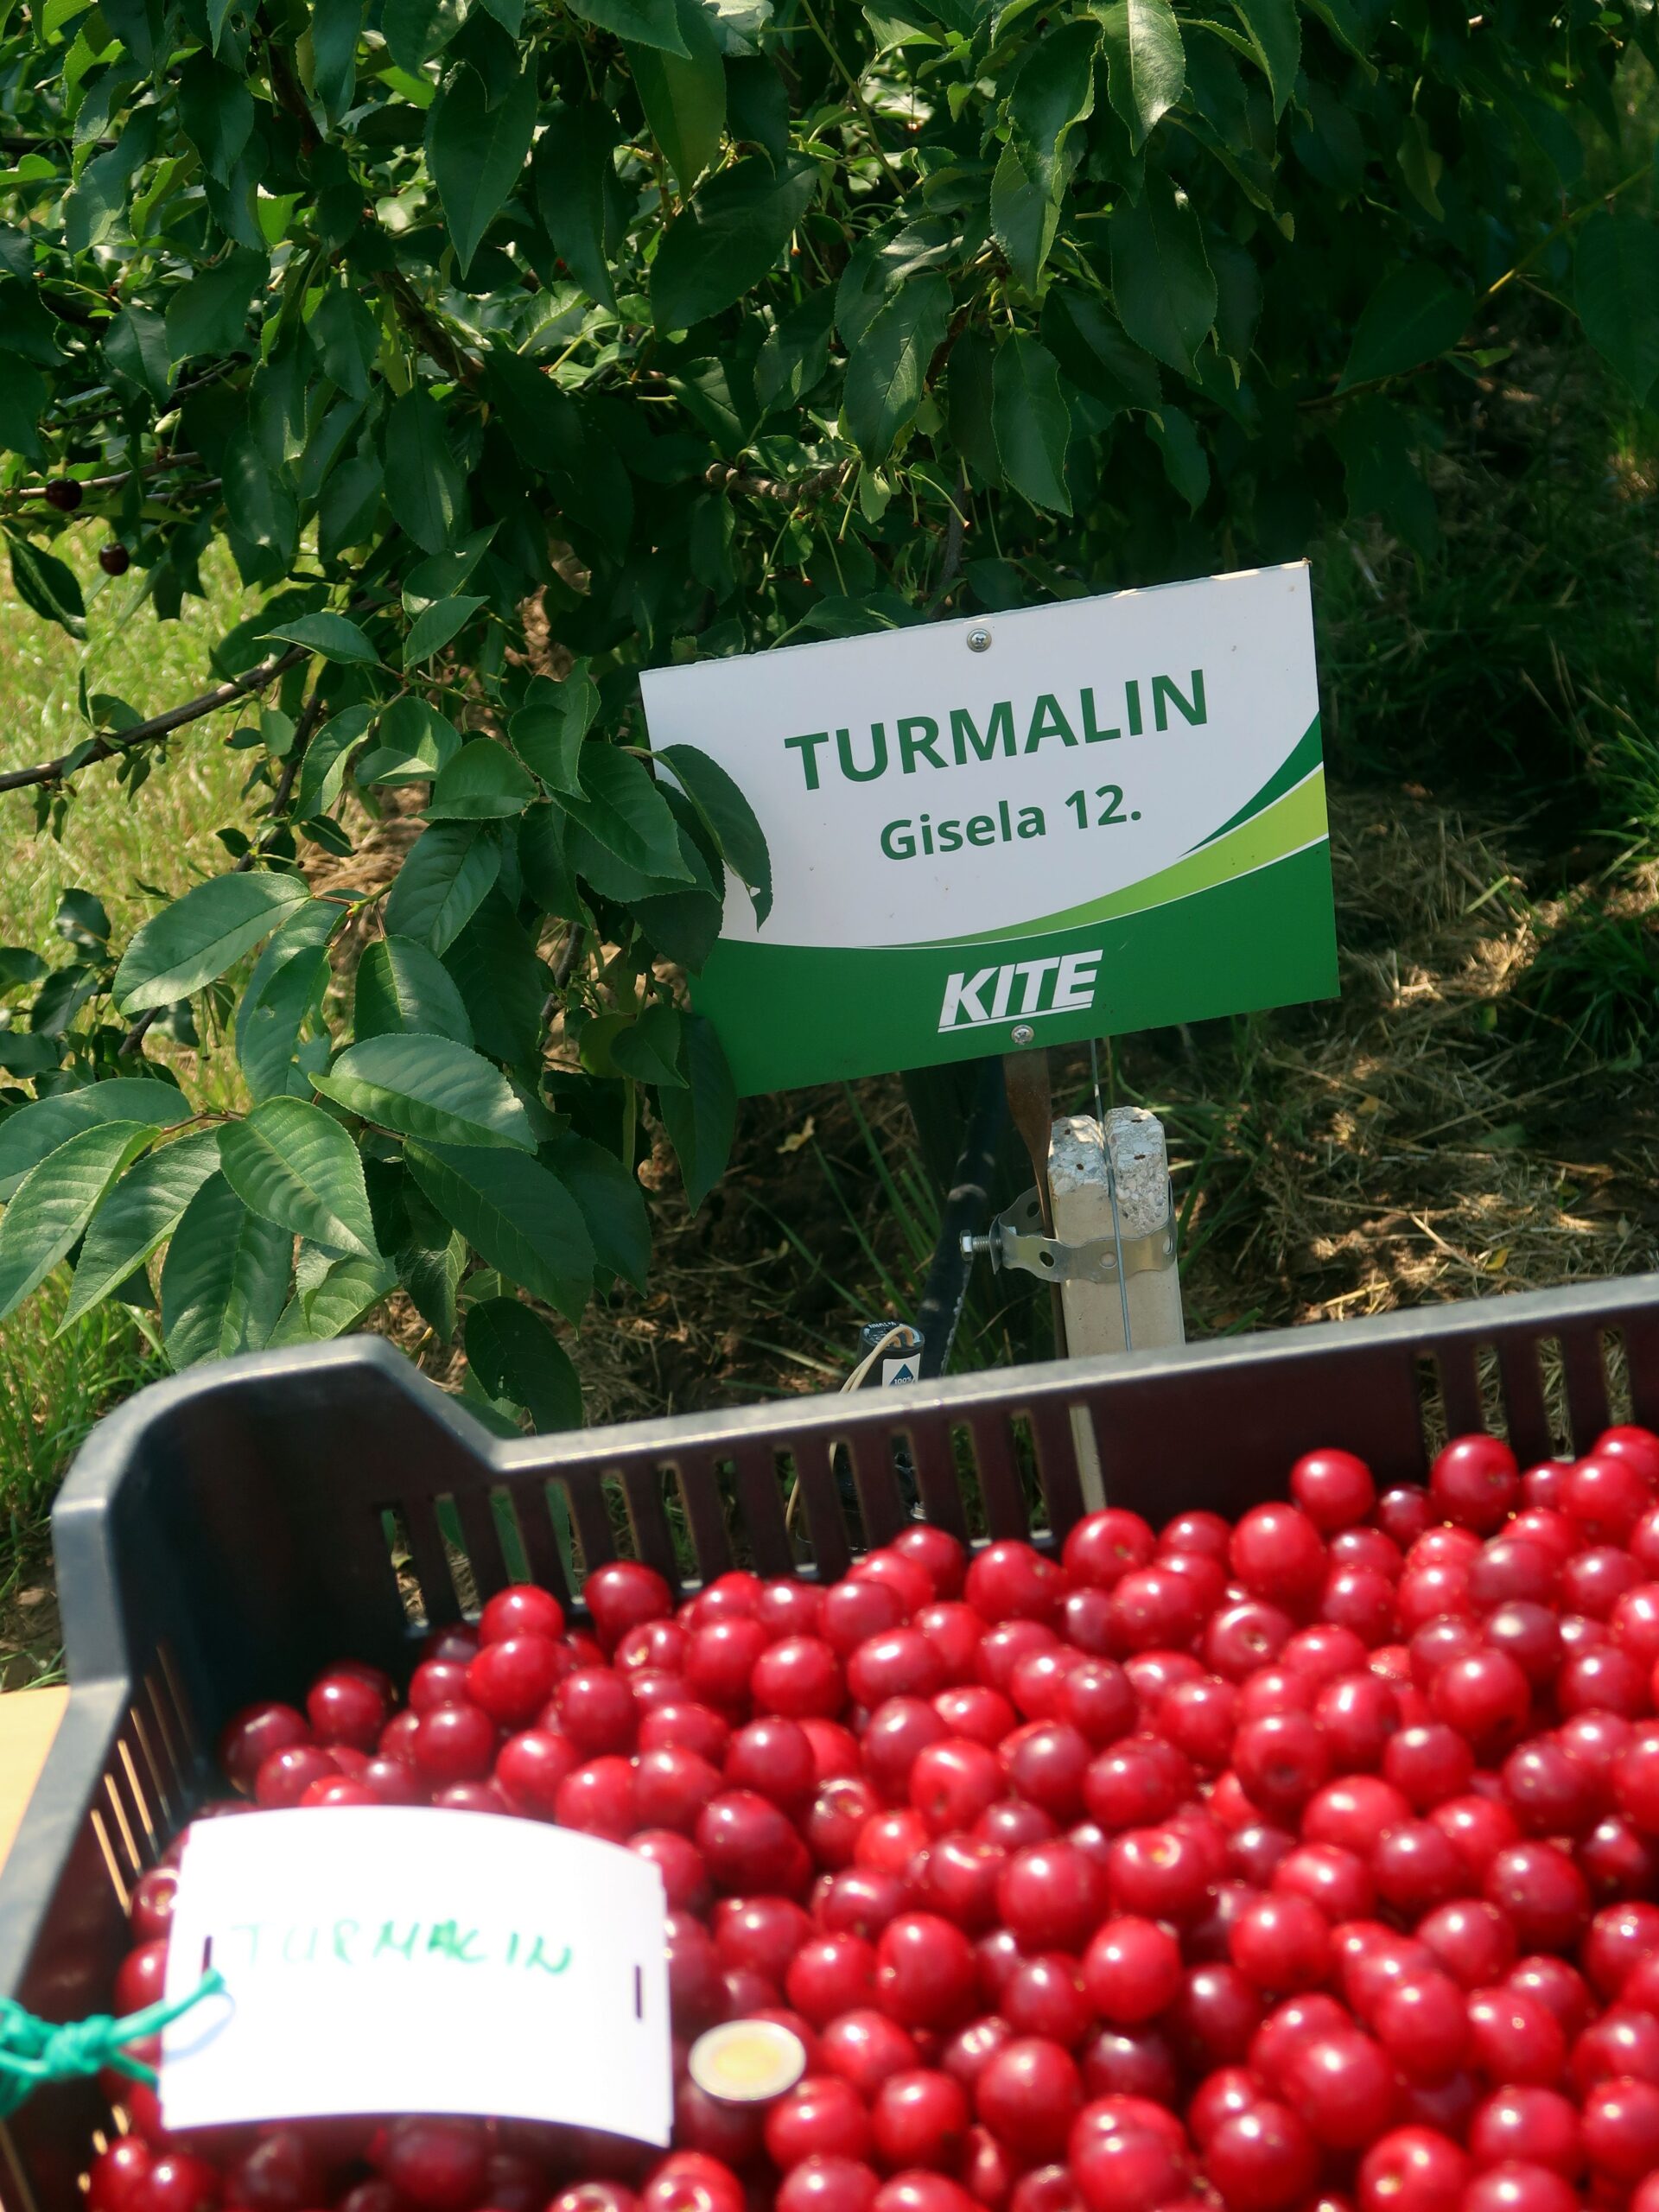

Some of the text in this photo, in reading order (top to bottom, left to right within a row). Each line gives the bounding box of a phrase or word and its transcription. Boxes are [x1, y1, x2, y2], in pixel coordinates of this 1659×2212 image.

[784, 669, 1208, 791] TURMALIN
[880, 784, 1141, 861] Gisela 12.
[938, 949, 1104, 1028] KITE
